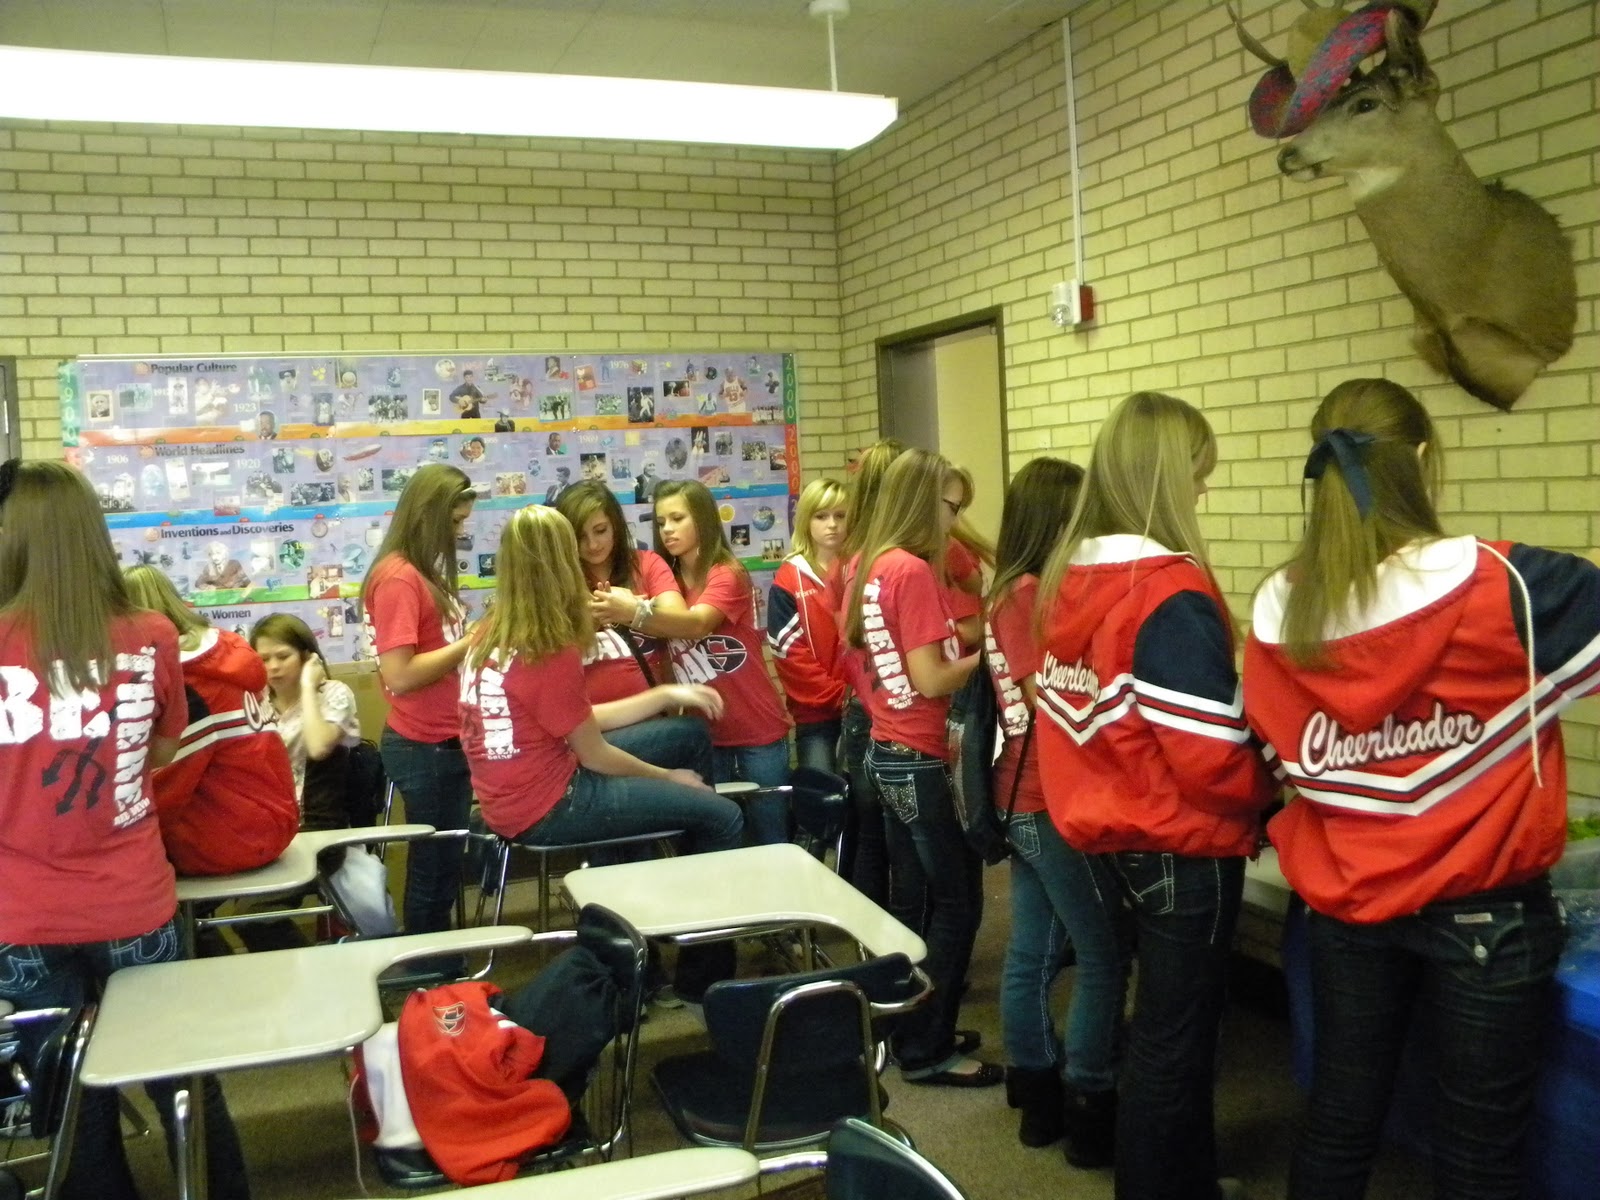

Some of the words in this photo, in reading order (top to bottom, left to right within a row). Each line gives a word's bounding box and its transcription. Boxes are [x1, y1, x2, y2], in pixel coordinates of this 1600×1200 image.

[151, 363, 194, 375] Popular
[197, 363, 237, 373] Culture
[233, 403, 256, 413] 1923
[155, 445, 187, 456] World
[191, 443, 245, 455] Headlines
[107, 454, 129, 464] 1906
[237, 459, 261, 469] 1920
[161, 527, 219, 538] Inventions
[232, 522, 294, 534] Discoveries
[211, 610, 251, 620] Women
[1301, 701, 1481, 774] Cheerleader
